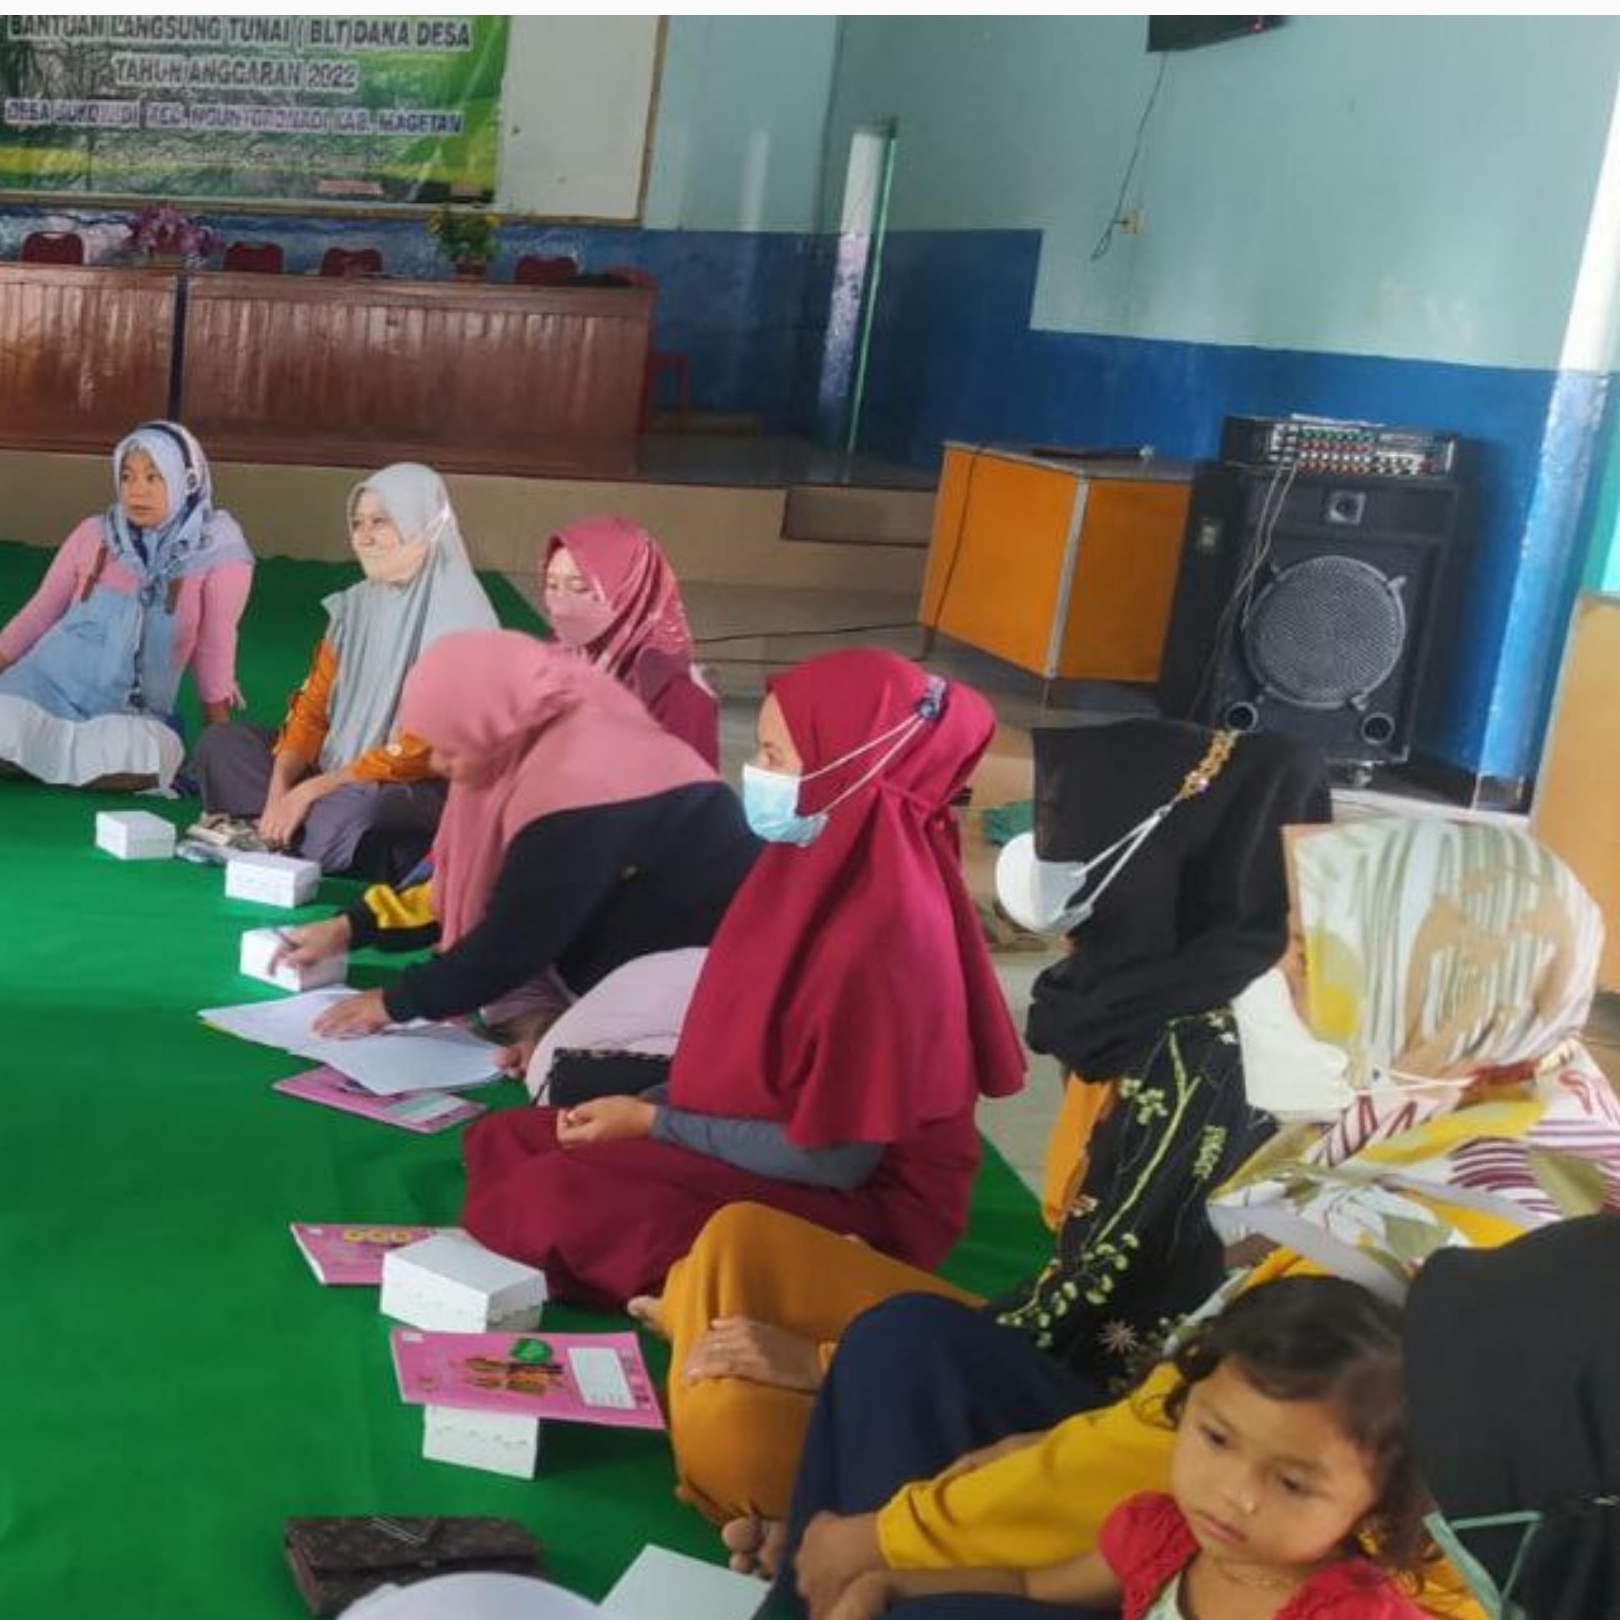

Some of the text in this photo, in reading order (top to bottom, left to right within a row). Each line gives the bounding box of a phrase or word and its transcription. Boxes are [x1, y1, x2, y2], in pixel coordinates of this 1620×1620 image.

[112, 15, 222, 40] LANGSUNG
[228, 16, 289, 42] TUNAI
[416, 22, 471, 48] DESA
